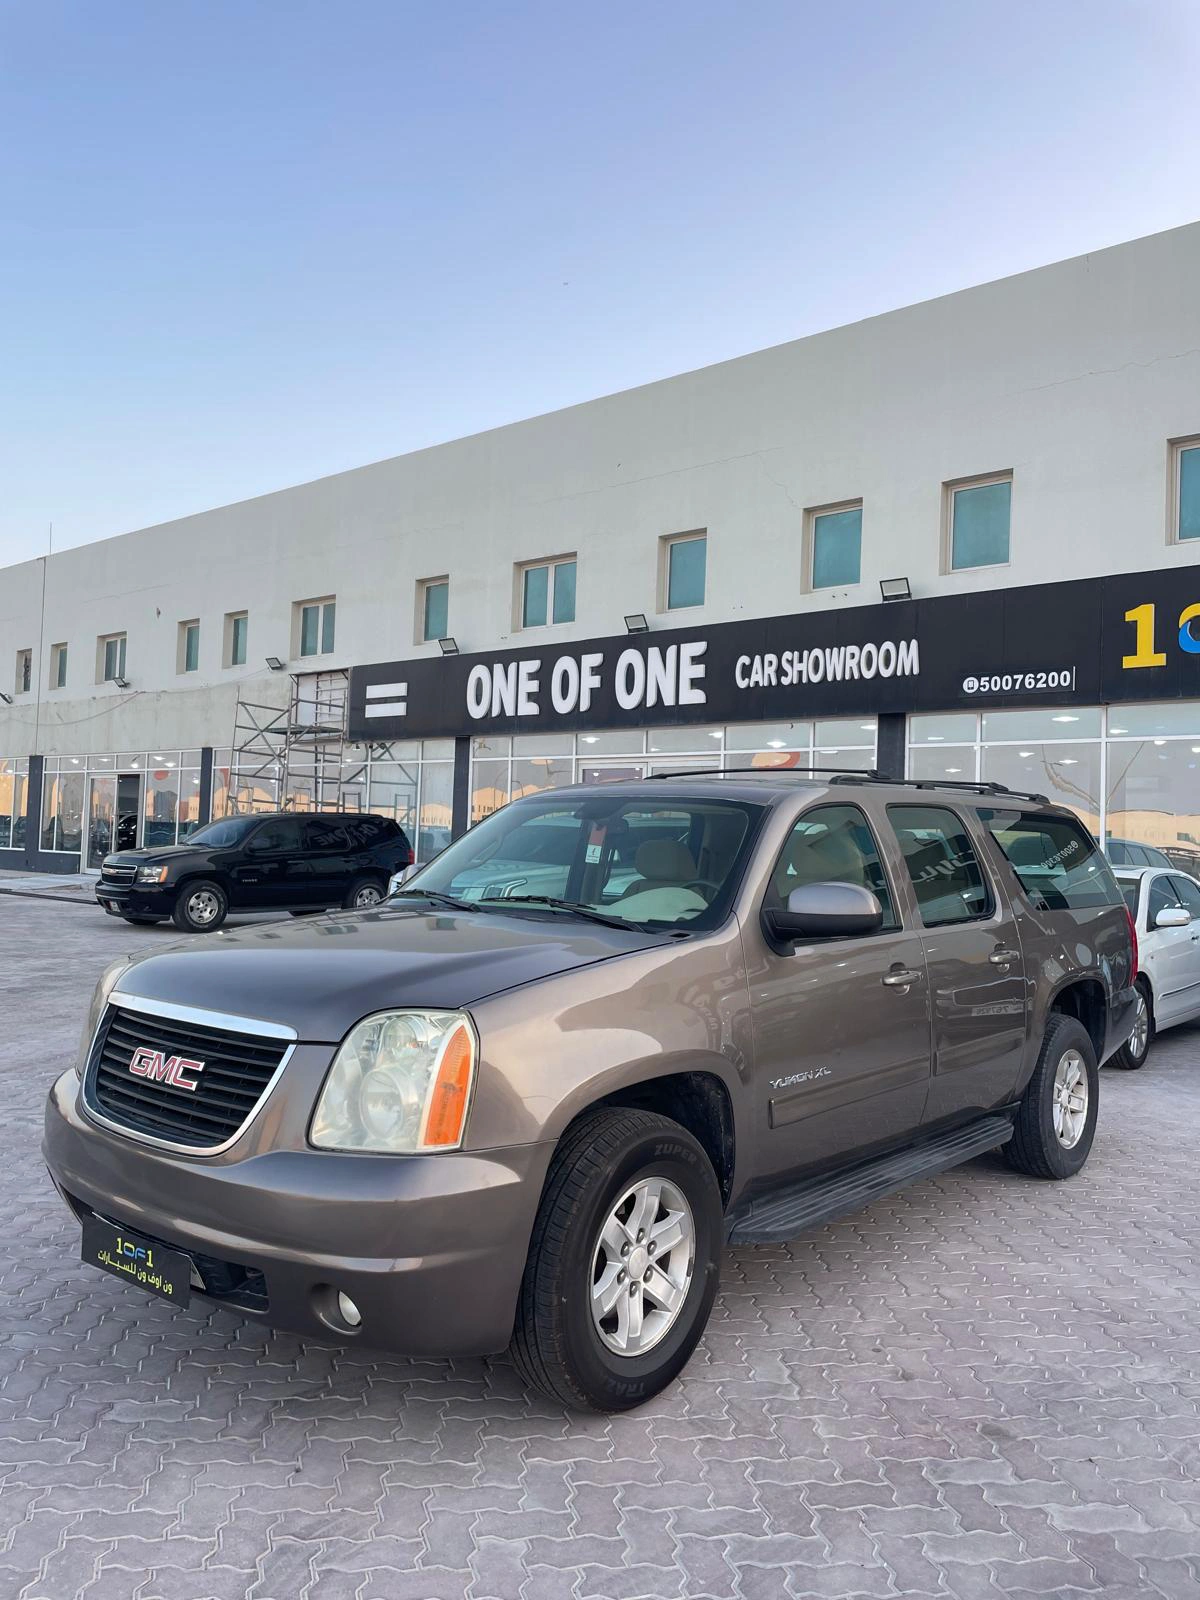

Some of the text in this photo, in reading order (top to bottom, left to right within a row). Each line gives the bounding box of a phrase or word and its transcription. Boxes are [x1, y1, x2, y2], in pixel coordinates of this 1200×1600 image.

[466, 640, 708, 720] ONE OF ONE
[780, 638, 921, 686] SHOWROOM
[979, 670, 1071, 692] 50076200
[129, 1046, 205, 1091] GMC
